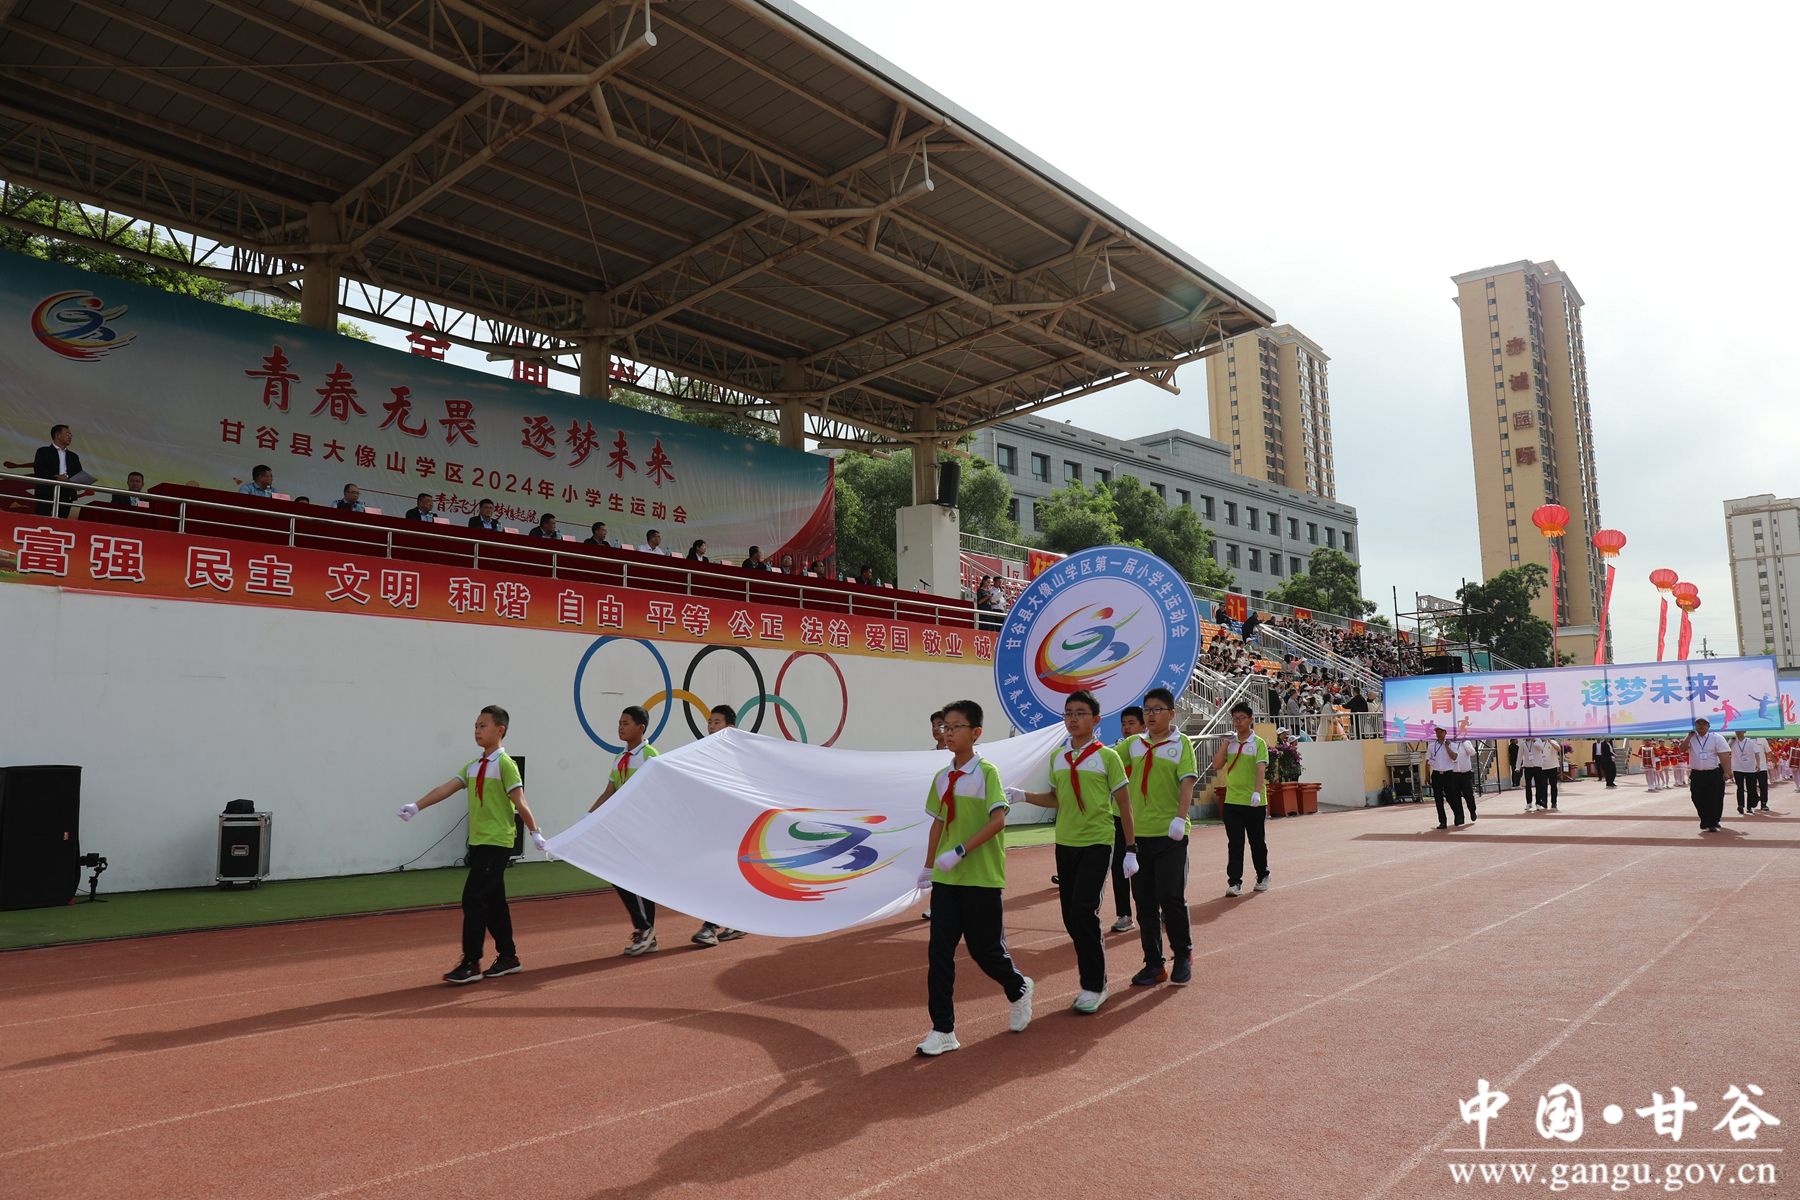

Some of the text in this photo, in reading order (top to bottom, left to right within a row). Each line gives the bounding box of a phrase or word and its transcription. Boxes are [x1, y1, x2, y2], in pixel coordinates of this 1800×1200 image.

[242, 344, 676, 488] 青春无畏 逐梦未来
[219, 418, 689, 526] 甘谷县大像山学区2024年小学生运动会
[13, 526, 145, 582] 富强
[184, 545, 294, 598] 民主
[326, 563, 420, 608] 文明
[448, 575, 532, 622] 和谐
[557, 589, 625, 628] 自由
[646, 600, 712, 636] 平等
[728, 609, 785, 641] 公正
[800, 615, 850, 648] 法治
[865, 623, 910, 653] 爱国
[922, 629, 964, 658] 敬业
[1005, 555, 1190, 651] 甘谷县大像山学区第一届小学生运动会
[1003, 673, 1044, 728] 青春无畏
[1428, 672, 1720, 715] 青春无畏 逐梦未来
